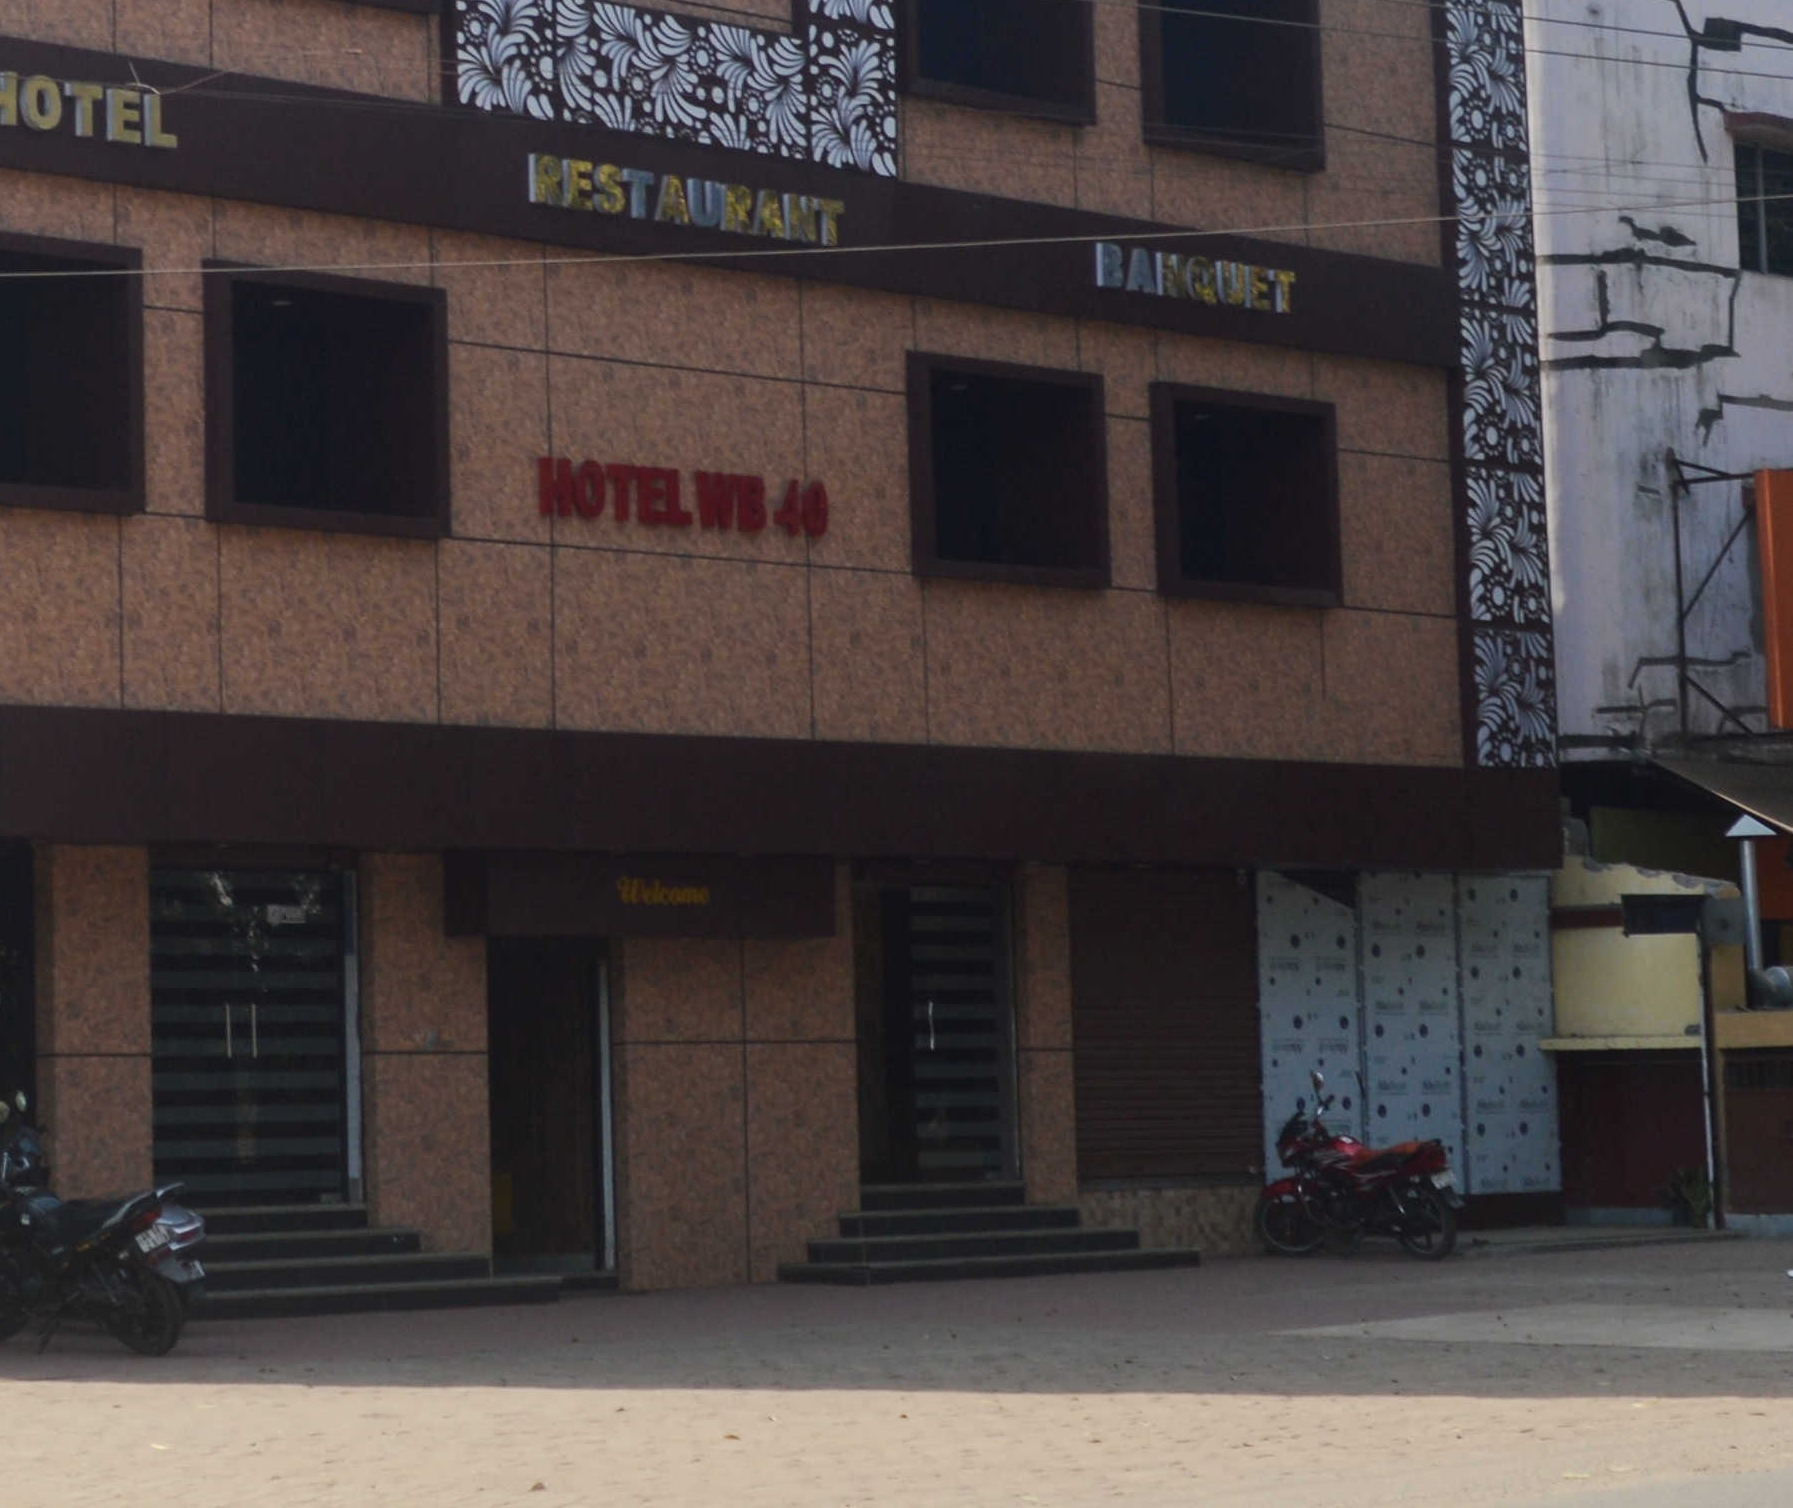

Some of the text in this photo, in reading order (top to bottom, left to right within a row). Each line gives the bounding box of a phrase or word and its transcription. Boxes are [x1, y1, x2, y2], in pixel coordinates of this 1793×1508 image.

[527, 153, 845, 247] RESTAURANT
[1095, 242, 1297, 314] BANQUET
[537, 456, 830, 538] HOTEL WB 40
[616, 876, 710, 905] Welcome
